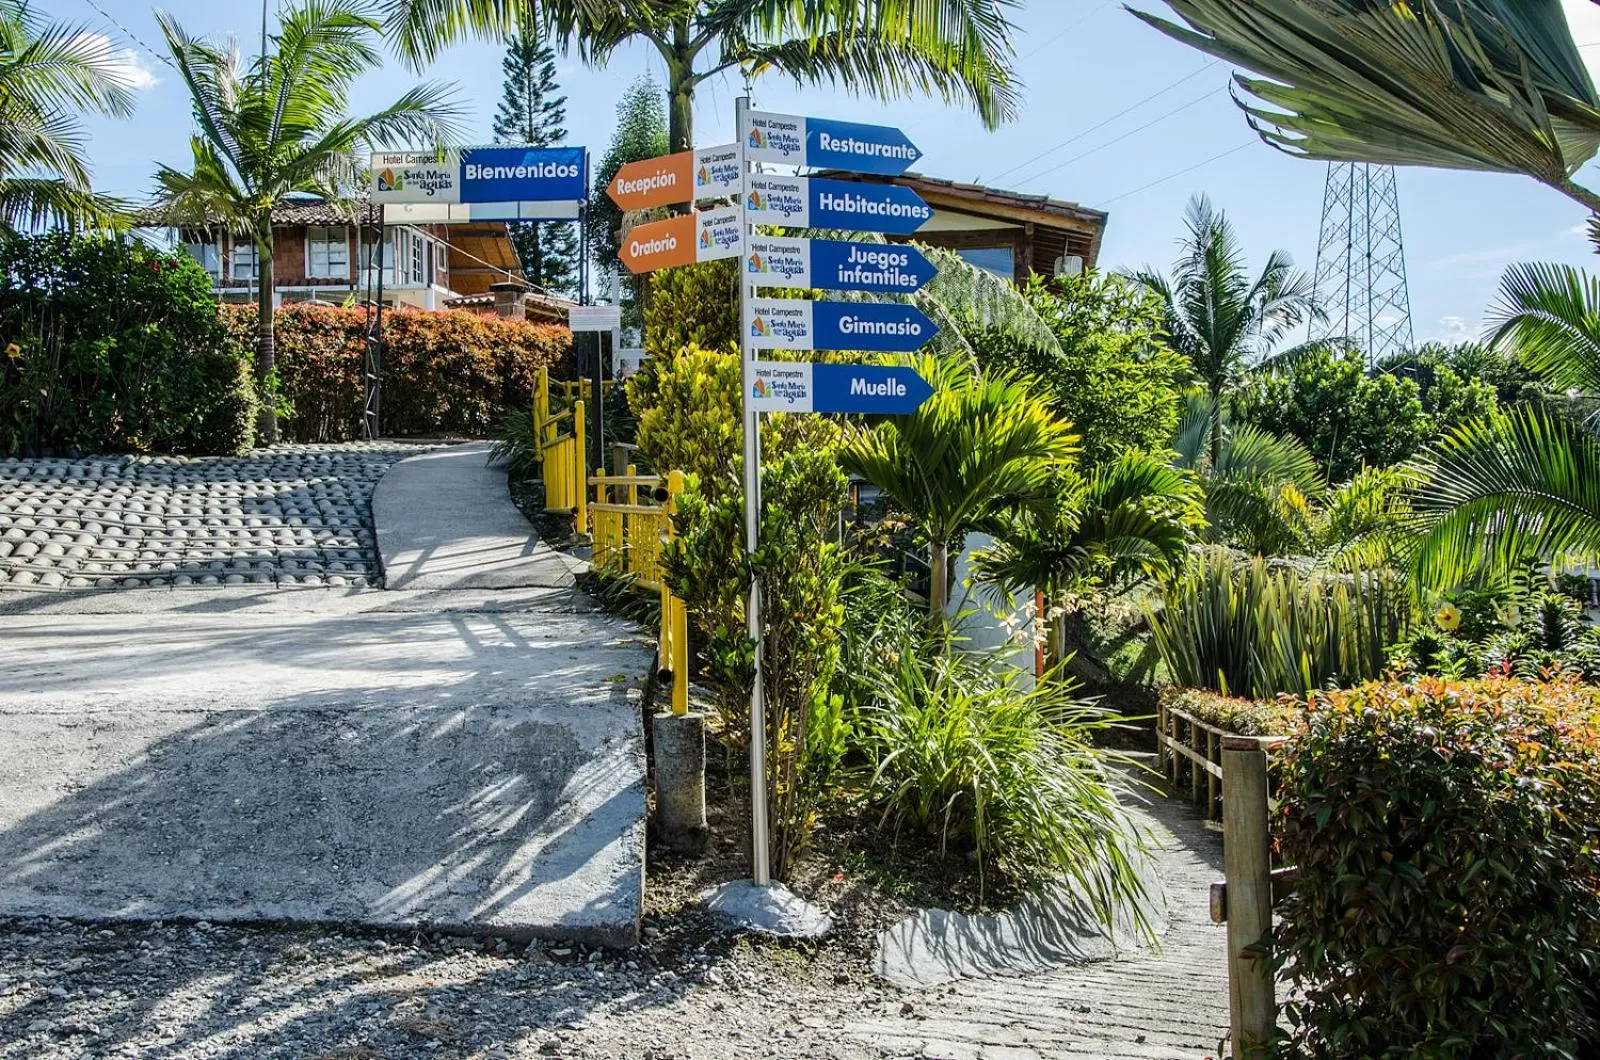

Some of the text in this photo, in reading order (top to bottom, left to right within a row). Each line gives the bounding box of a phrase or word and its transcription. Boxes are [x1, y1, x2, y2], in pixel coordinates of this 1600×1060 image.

[819, 132, 917, 160] Restaurante
[383, 154, 403, 165] Hotel
[465, 161, 579, 181] Bienvenidos
[616, 169, 676, 196] Recepción
[751, 180, 767, 190] Hotel
[819, 192, 930, 219] Habitaciones
[630, 232, 677, 258] Oratorio
[751, 243, 768, 252] Hotel
[848, 246, 909, 270] Juegos
[838, 264, 918, 287] infantiles
[754, 307, 771, 316] Hotel
[838, 315, 922, 336] Gimnasio
[756, 368, 772, 378] Hotel
[850, 377, 907, 397] Muelle
